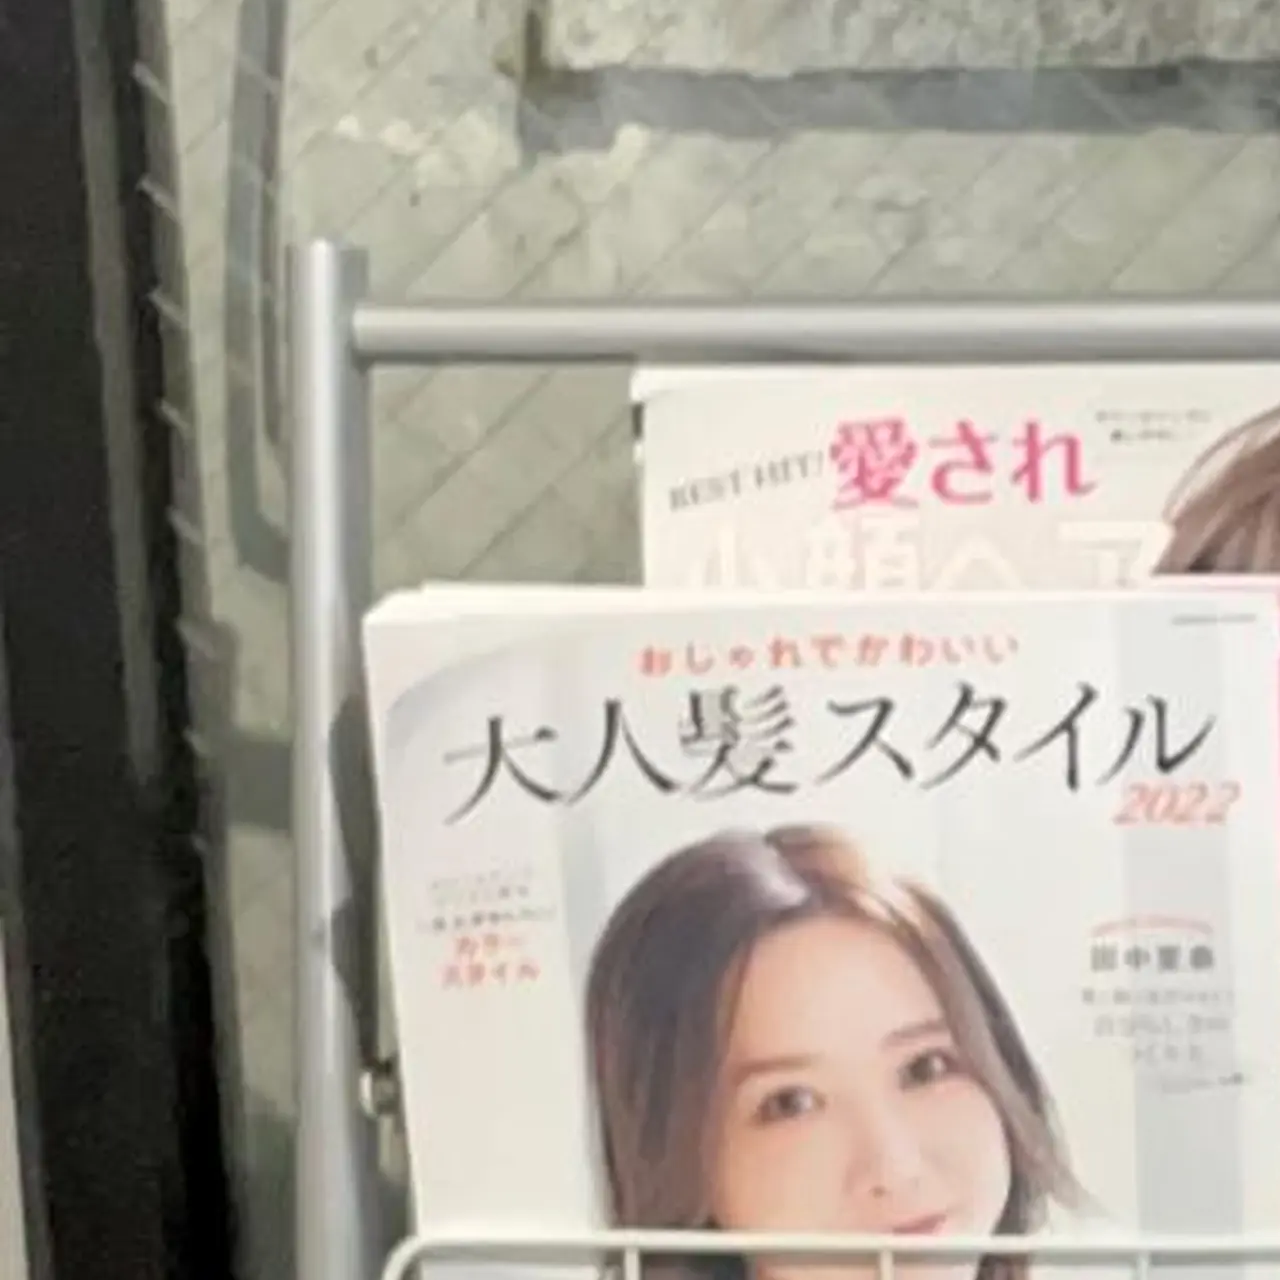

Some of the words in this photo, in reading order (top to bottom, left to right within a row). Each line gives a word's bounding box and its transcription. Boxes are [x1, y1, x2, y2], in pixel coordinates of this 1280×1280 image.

[828, 414, 1098, 511] 愛され
[668, 470, 743, 512] BEST
[640, 632, 1020, 678] おしゃれでかわいい
[442, 680, 1217, 827] 大人髪スタイル
[1112, 780, 1242, 826] 2022
